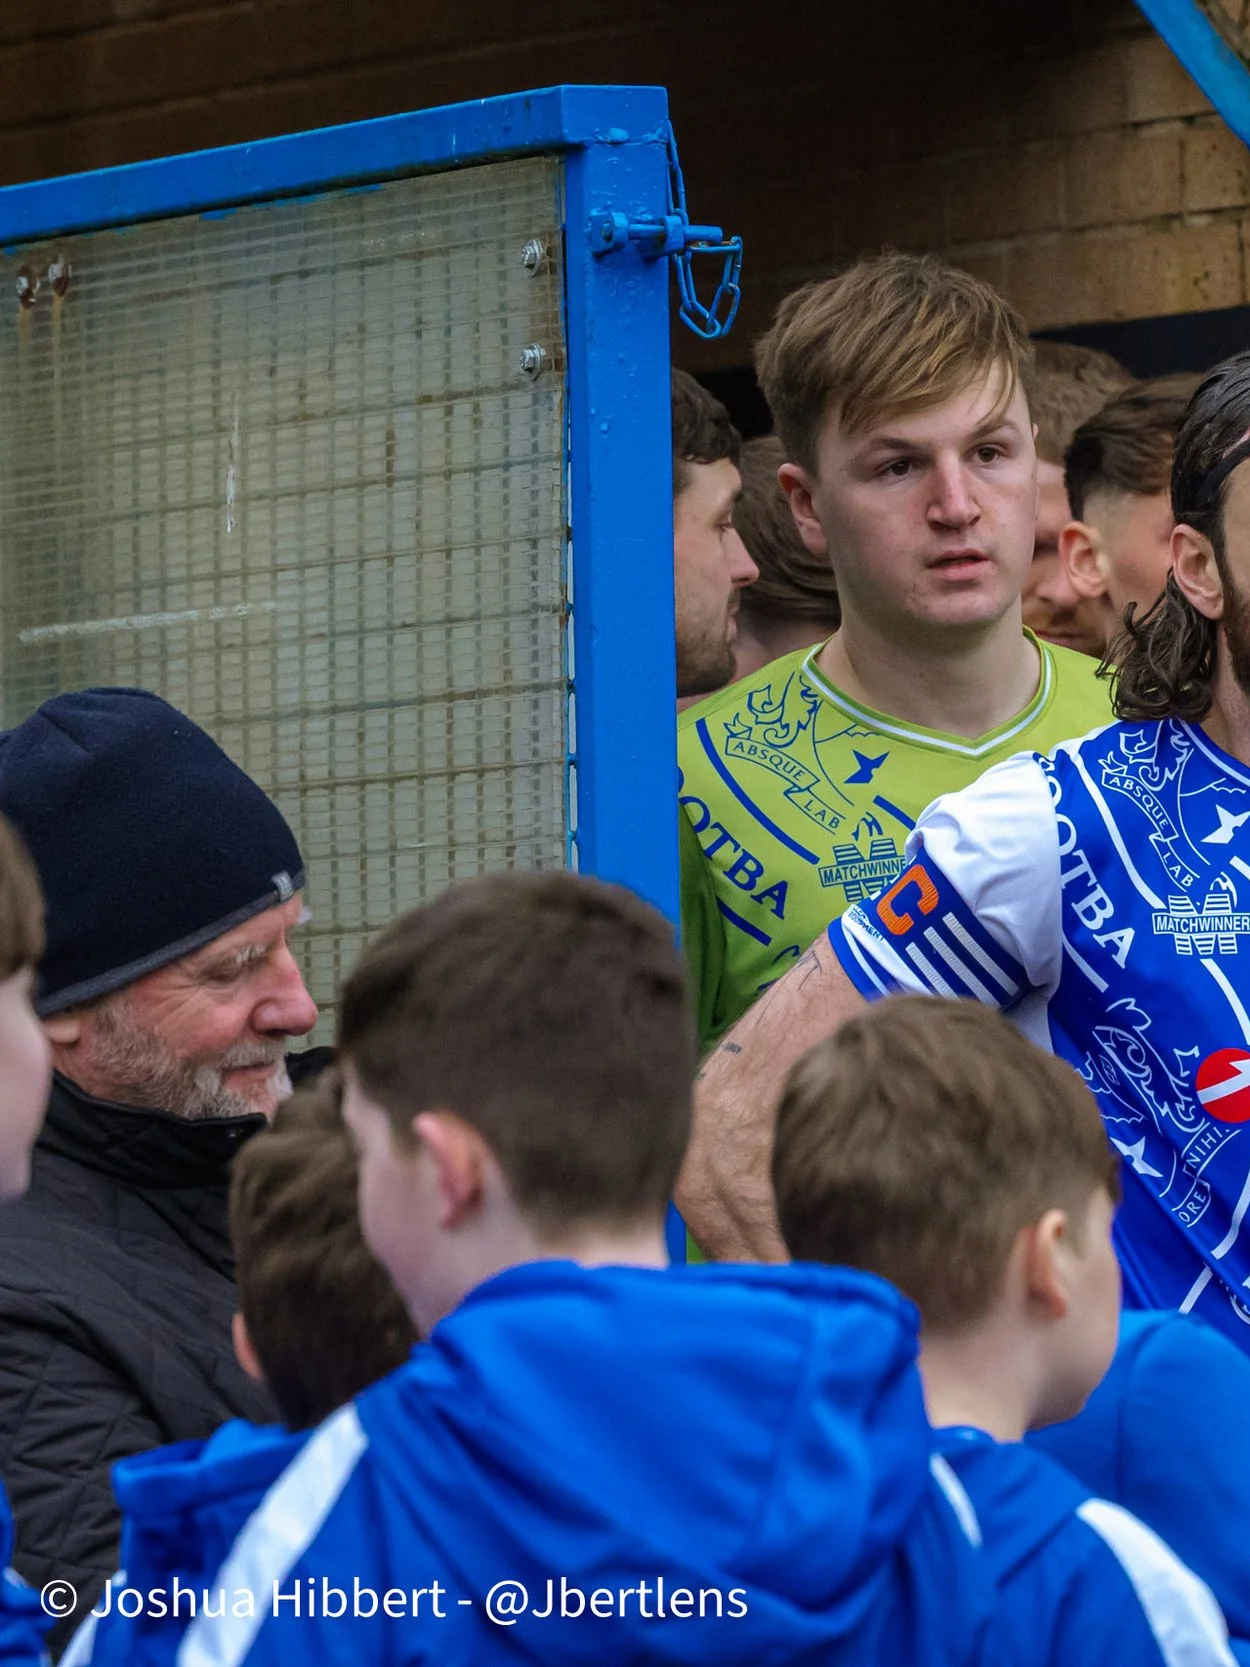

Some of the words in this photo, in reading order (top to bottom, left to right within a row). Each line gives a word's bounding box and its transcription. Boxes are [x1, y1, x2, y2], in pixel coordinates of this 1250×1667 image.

[732, 742, 806, 782] ABSQUE
[804, 799, 842, 830] LAB
[1108, 775, 1170, 828] ABSQUE
[1162, 854, 1194, 888] LAB
[824, 858, 906, 884] MATCHWINNE
[875, 863, 940, 936] C
[1155, 915, 1250, 934] MATCHWINNER
[1185, 1126, 1228, 1169] NIHI
[1178, 1191, 1207, 1223] ORE
